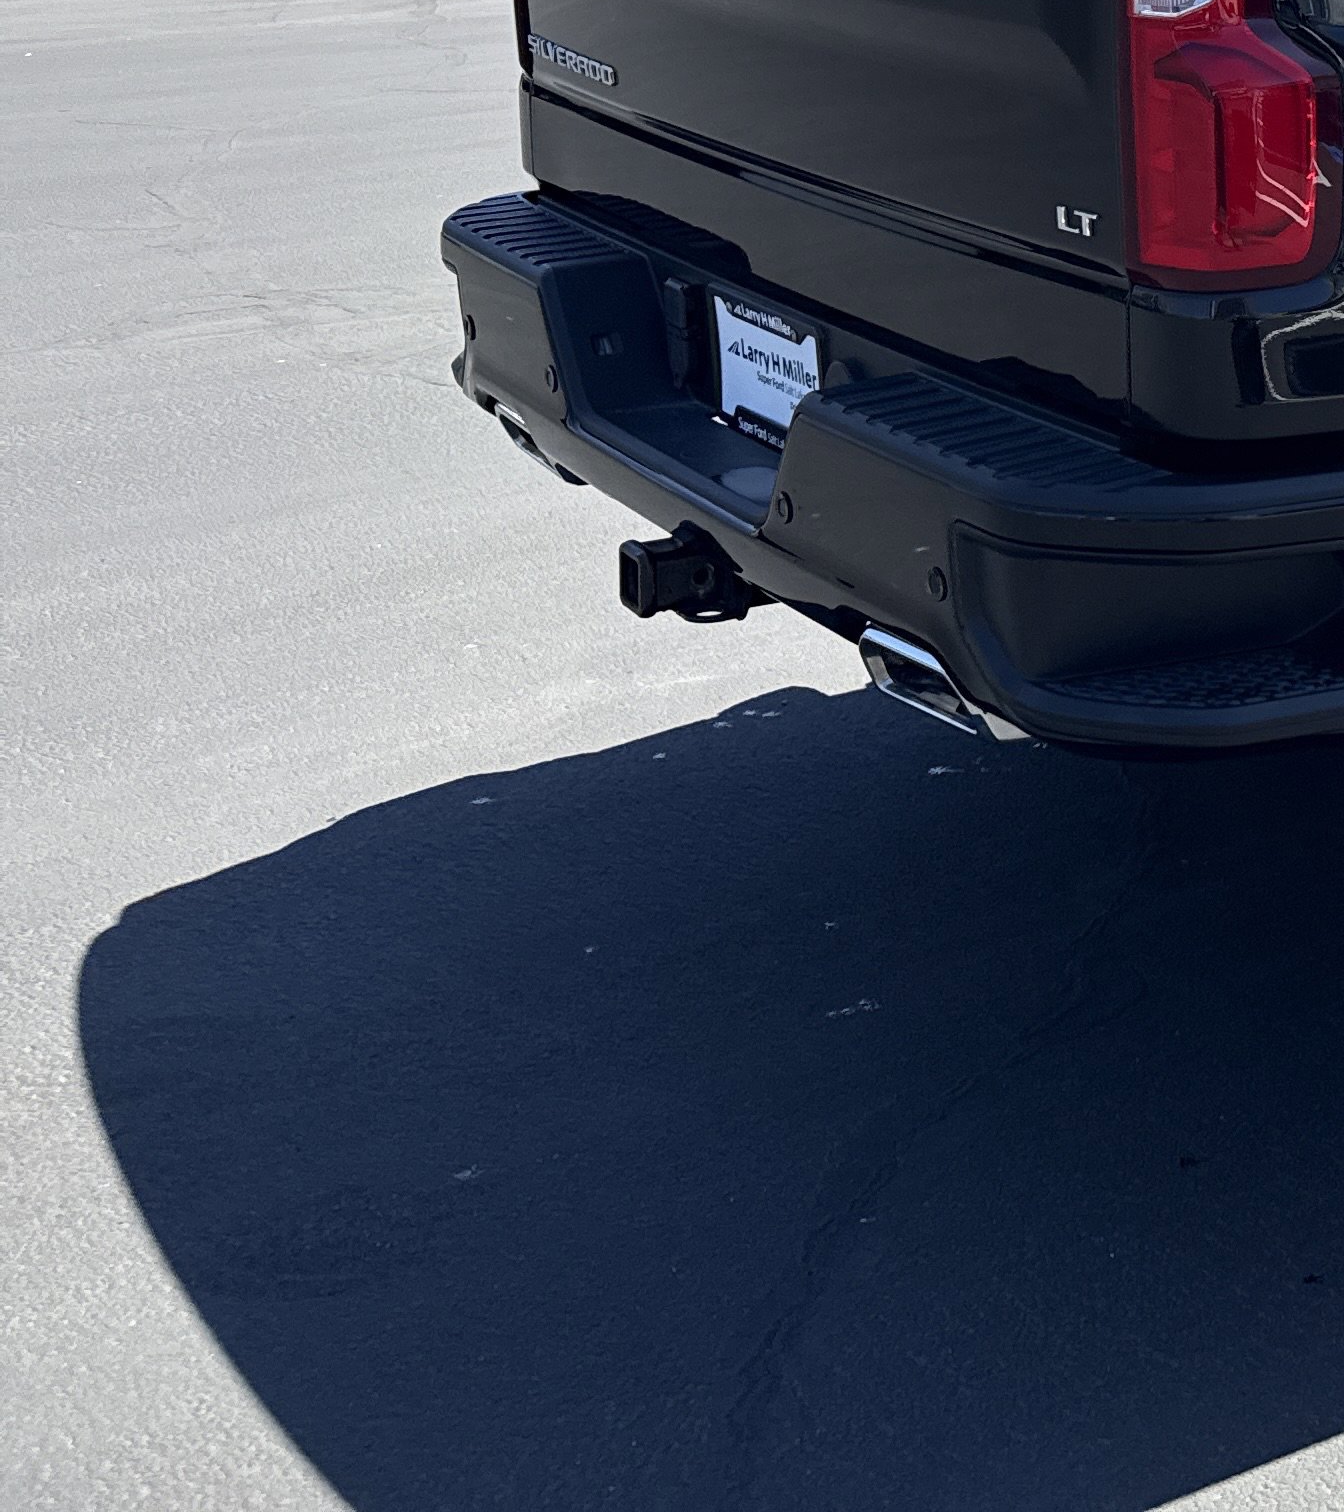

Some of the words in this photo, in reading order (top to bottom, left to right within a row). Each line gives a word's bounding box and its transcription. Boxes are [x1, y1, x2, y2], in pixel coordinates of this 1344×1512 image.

[527, 33, 616, 87] SILVERADO
[1056, 206, 1098, 237] LT
[740, 303, 761, 326] Larry
[761, 312, 769, 327] H
[768, 314, 791, 337] Miller
[740, 338, 770, 375] Larry
[771, 352, 781, 376] H
[782, 357, 817, 391] Miller
